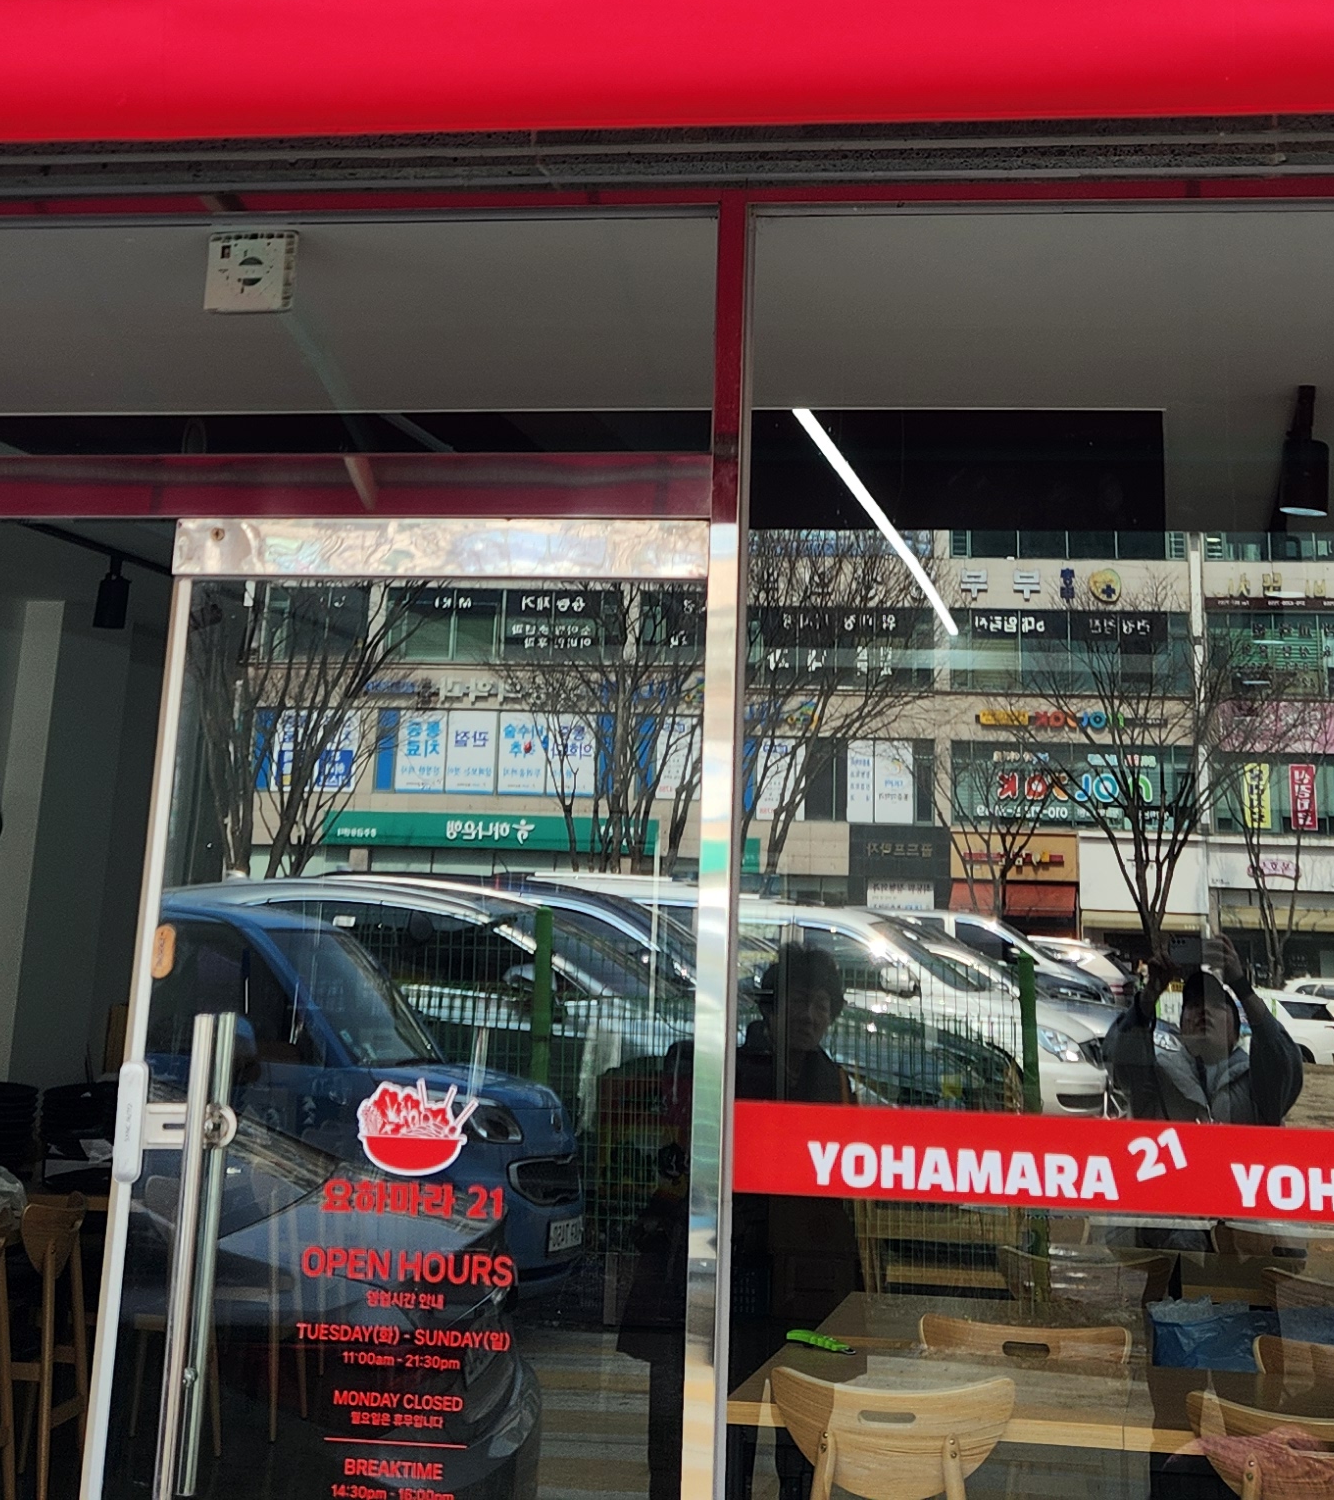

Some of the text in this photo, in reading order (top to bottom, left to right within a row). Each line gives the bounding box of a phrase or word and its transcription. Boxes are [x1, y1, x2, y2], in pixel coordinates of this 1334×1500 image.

[807, 1127, 1188, 1202] YOHAMARA 21
[320, 1177, 504, 1220] 요하마라 21
[301, 1245, 515, 1288] OPEN HOURS
[366, 1290, 445, 1310] 영업시간 안내
[295, 1322, 400, 1345] TUESDAY(화)
[413, 1328, 512, 1352] SUNDAY(일)
[404, 1354, 461, 1371] 21:30pm
[332, 1389, 464, 1413] MONDAY CLOSED
[350, 1411, 445, 1430] 월요일은 휴무입니다
[343, 1457, 445, 1481] BREAKTIME
[331, 1483, 388, 1500] 14:30pm
